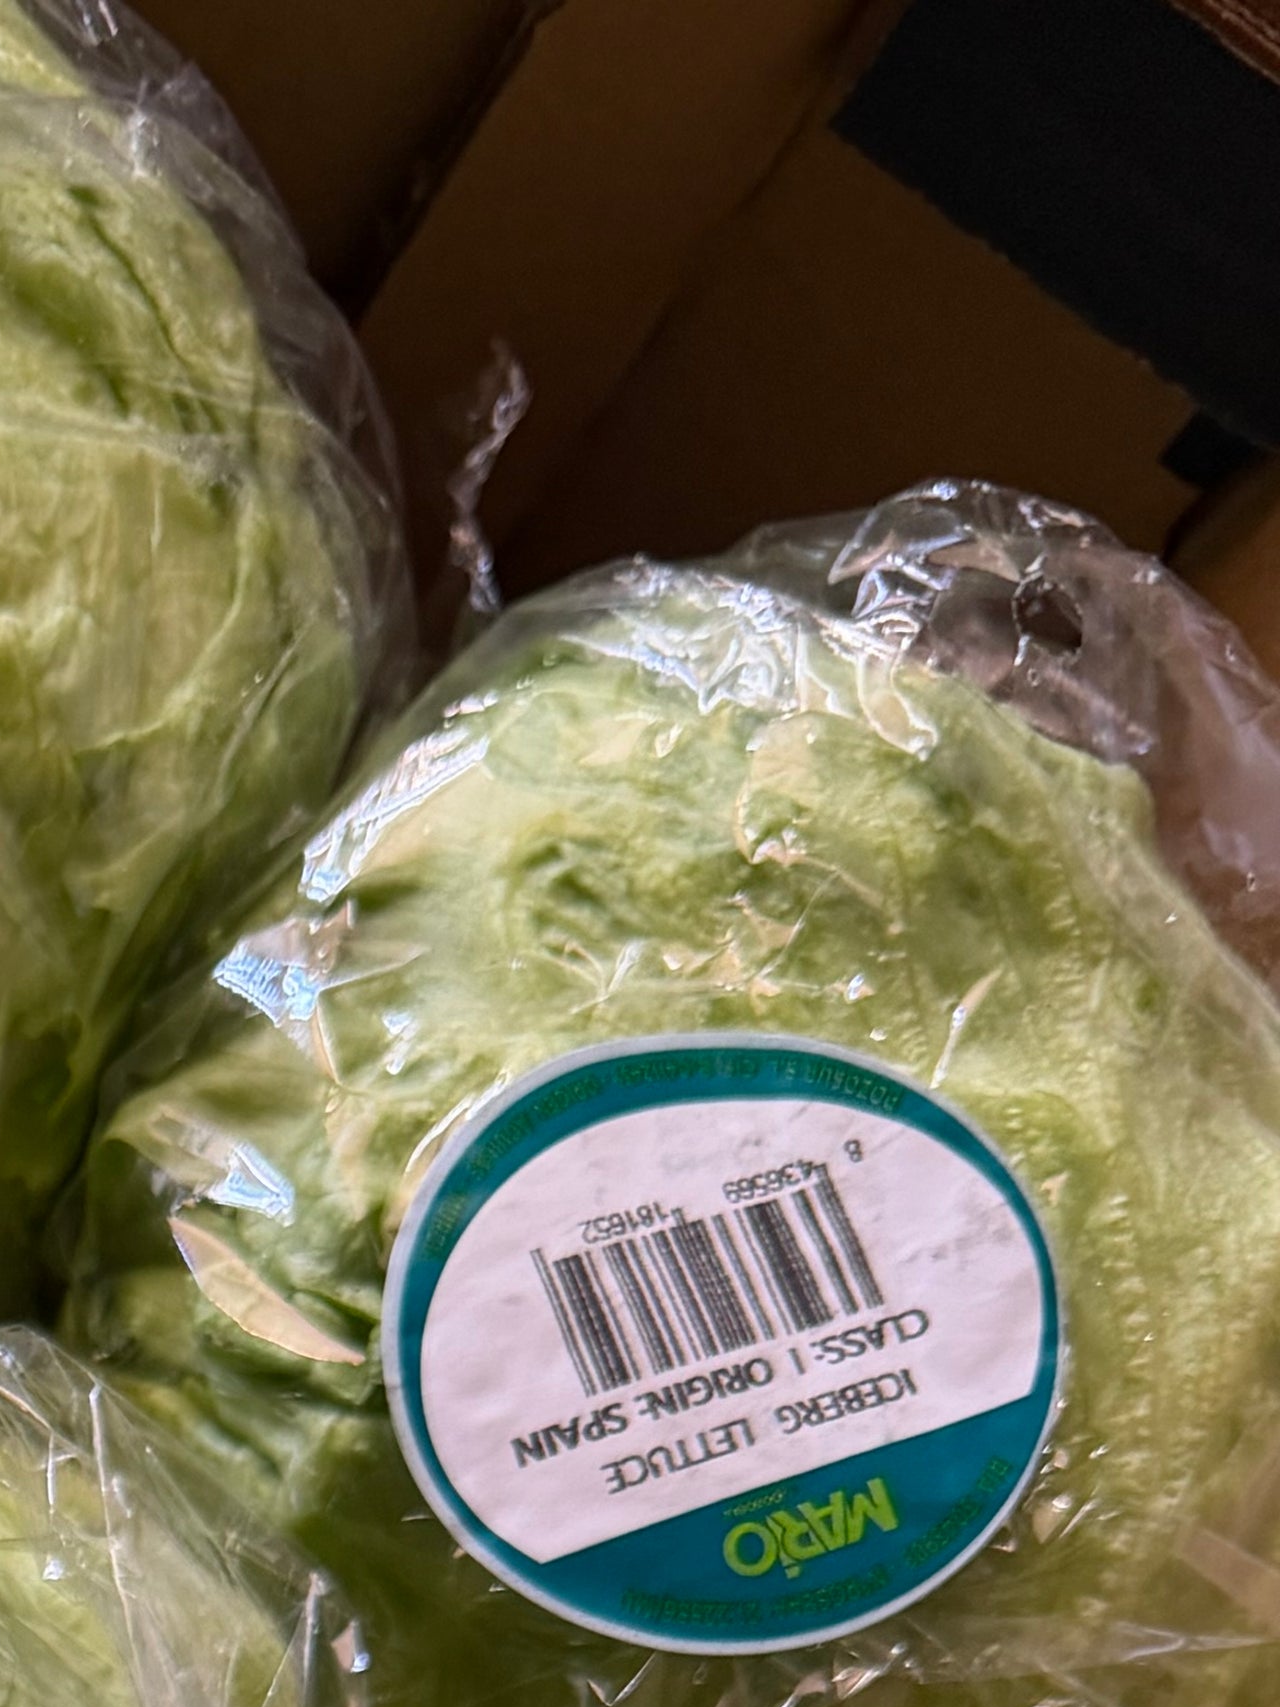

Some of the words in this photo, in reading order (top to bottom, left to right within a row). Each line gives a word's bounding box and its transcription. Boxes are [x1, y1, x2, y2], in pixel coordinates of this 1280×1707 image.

[844, 1139, 863, 1162] 8
[722, 1159, 812, 1203] 436569
[578, 1202, 668, 1243] 181652
[788, 1347, 805, 1374] I
[809, 1308, 929, 1363] CLASS:
[634, 1357, 773, 1419] ORIGIN:
[774, 1368, 916, 1433] ICEBERG
[510, 1402, 628, 1466] SPAIN
[600, 1417, 755, 1494] LETTUCE
